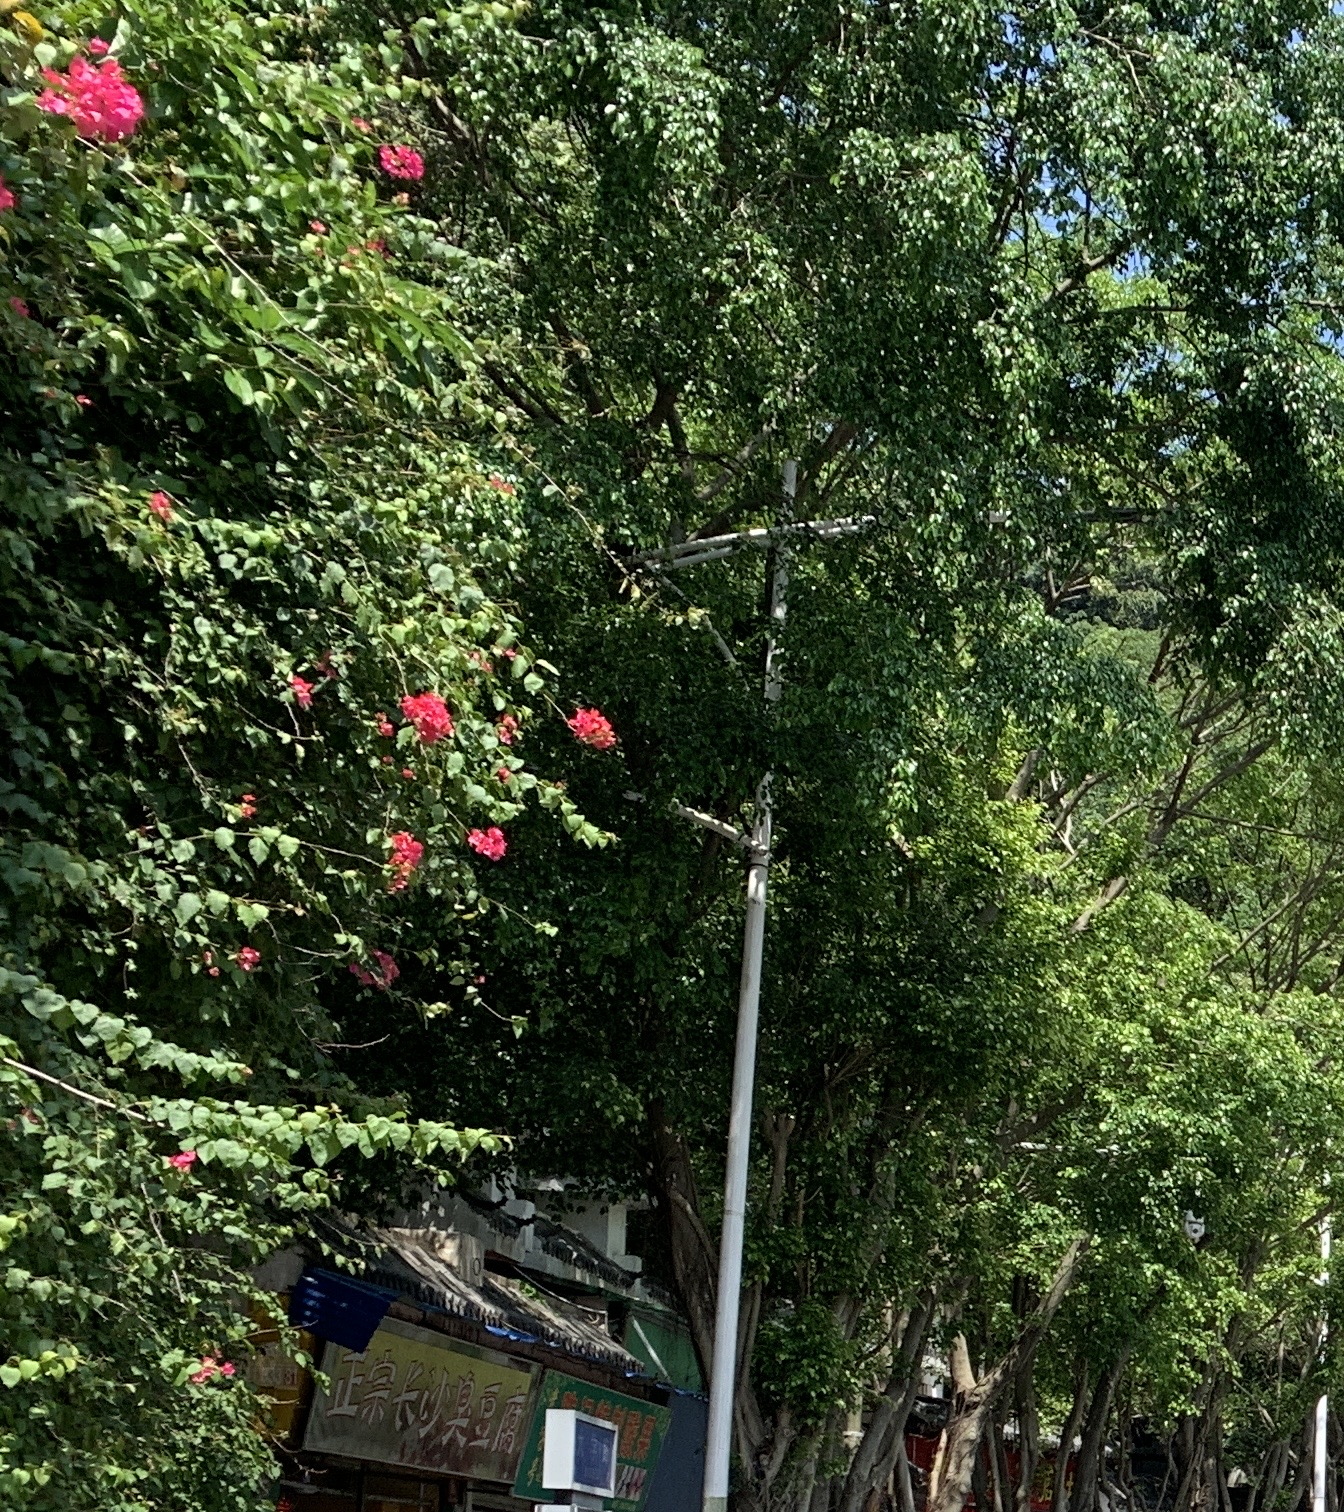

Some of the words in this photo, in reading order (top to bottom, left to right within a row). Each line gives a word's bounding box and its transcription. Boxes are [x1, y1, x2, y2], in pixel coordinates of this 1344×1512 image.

[326, 1350, 528, 1454] 正宗长沙臭豆腐
